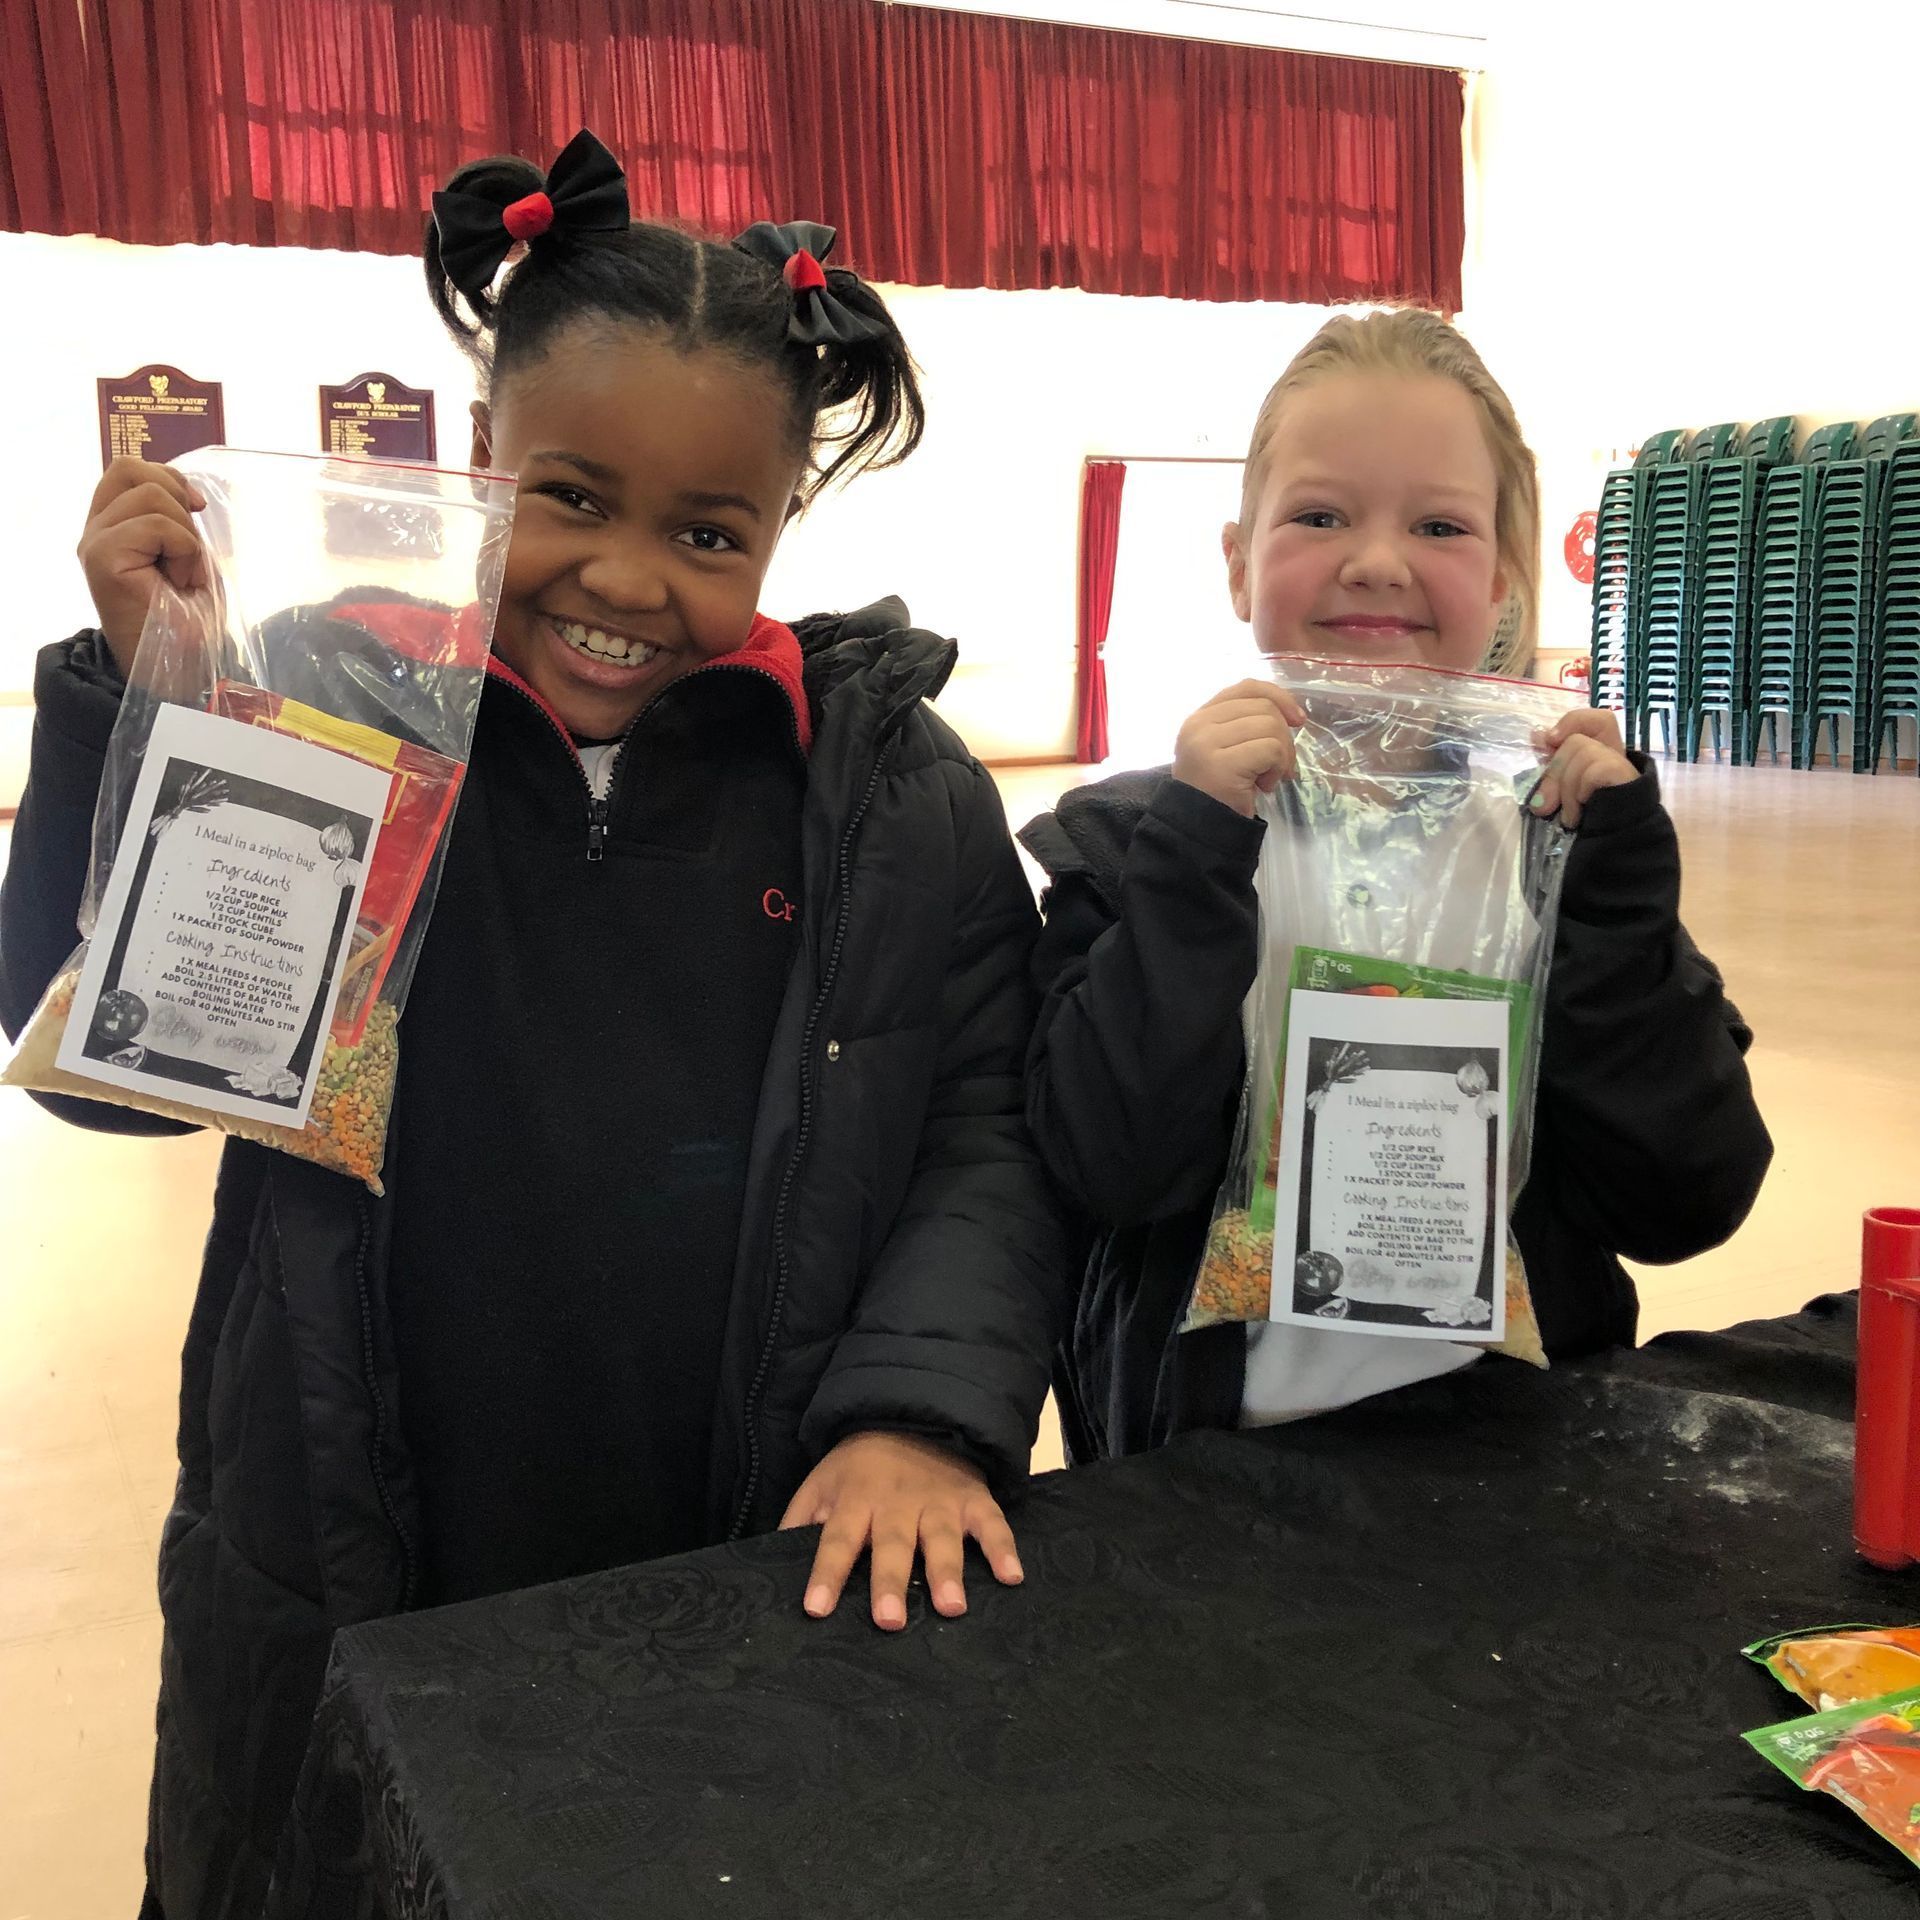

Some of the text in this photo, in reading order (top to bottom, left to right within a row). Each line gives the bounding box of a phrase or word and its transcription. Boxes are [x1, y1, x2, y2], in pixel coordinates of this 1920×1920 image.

[112, 395, 208, 406] CRAWFORD PREPARATORY
[333, 402, 421, 412] CRAWFORD PREPARATORY
[202, 828, 233, 845] Meal
[235, 838, 246, 849] in
[249, 843, 256, 851] a
[259, 845, 294, 862] ziploc
[296, 853, 316, 872] bag
[207, 859, 291, 892] Ingredients
[206, 891, 288, 918] 1/2 CUP SOUP MIX
[222, 885, 280, 906] 1/2 CUP RICE
[210, 902, 282, 926] 1/2 CUP LENTILS
[218, 914, 249, 928] STOCK
[252, 923, 274, 934] CUBE
[177, 914, 185, 922] X
[187, 916, 222, 930] PACKET
[225, 925, 237, 934] OF
[240, 930, 264, 941] SOUP
[267, 937, 304, 953] POWDER
[166, 931, 214, 957] Cooking
[175, 965, 293, 1001] BOIL 2.5 LITERS OF WATER
[196, 961, 219, 972] MEAL
[223, 967, 249, 980] FEEDS
[260, 977, 293, 991] PEOPLE
[161, 972, 300, 1013] ADD CONTENTS OF BAG TO THE
[193, 990, 264, 1014] BOILING WATER
[155, 991, 295, 1032] BOIL FOR 40 MINUTES AND STIR
[207, 1014, 237, 1027] OFTEN
[1355, 1096, 1381, 1109] Meal
[1384, 1098, 1395, 1109] in
[1441, 1100, 1459, 1115] bag
[1365, 1122, 1442, 1139] Ingredients
[1370, 1151, 1383, 1159] 1/2
[1384, 1170, 1412, 1178] STOCK
[1415, 1172, 1436, 1180] CUBE
[1410, 1163, 1441, 1171] LENTILS
[1359, 1177, 1390, 1185] PACKET
[1407, 1180, 1429, 1188] SOUP
[1431, 1182, 1465, 1190] POWDER
[1358, 1222, 1375, 1230] BOIL
[1394, 1225, 1421, 1233] LITERS
[1437, 1228, 1465, 1236] WATER
[1375, 1215, 1396, 1223] MEAL
[1434, 1219, 1463, 1227] PEOPLE
[1368, 1232, 1411, 1241] CONTENTS
[1346, 1247, 1363, 1255] BOIL
[1398, 1251, 1434, 1260] MINUTES
[1437, 1254, 1454, 1262] AND
[1457, 1255, 1474, 1263] STIR
[1378, 1242, 1443, 1252] BOILING WATER
[1395, 1260, 1422, 1268] OFTEN
